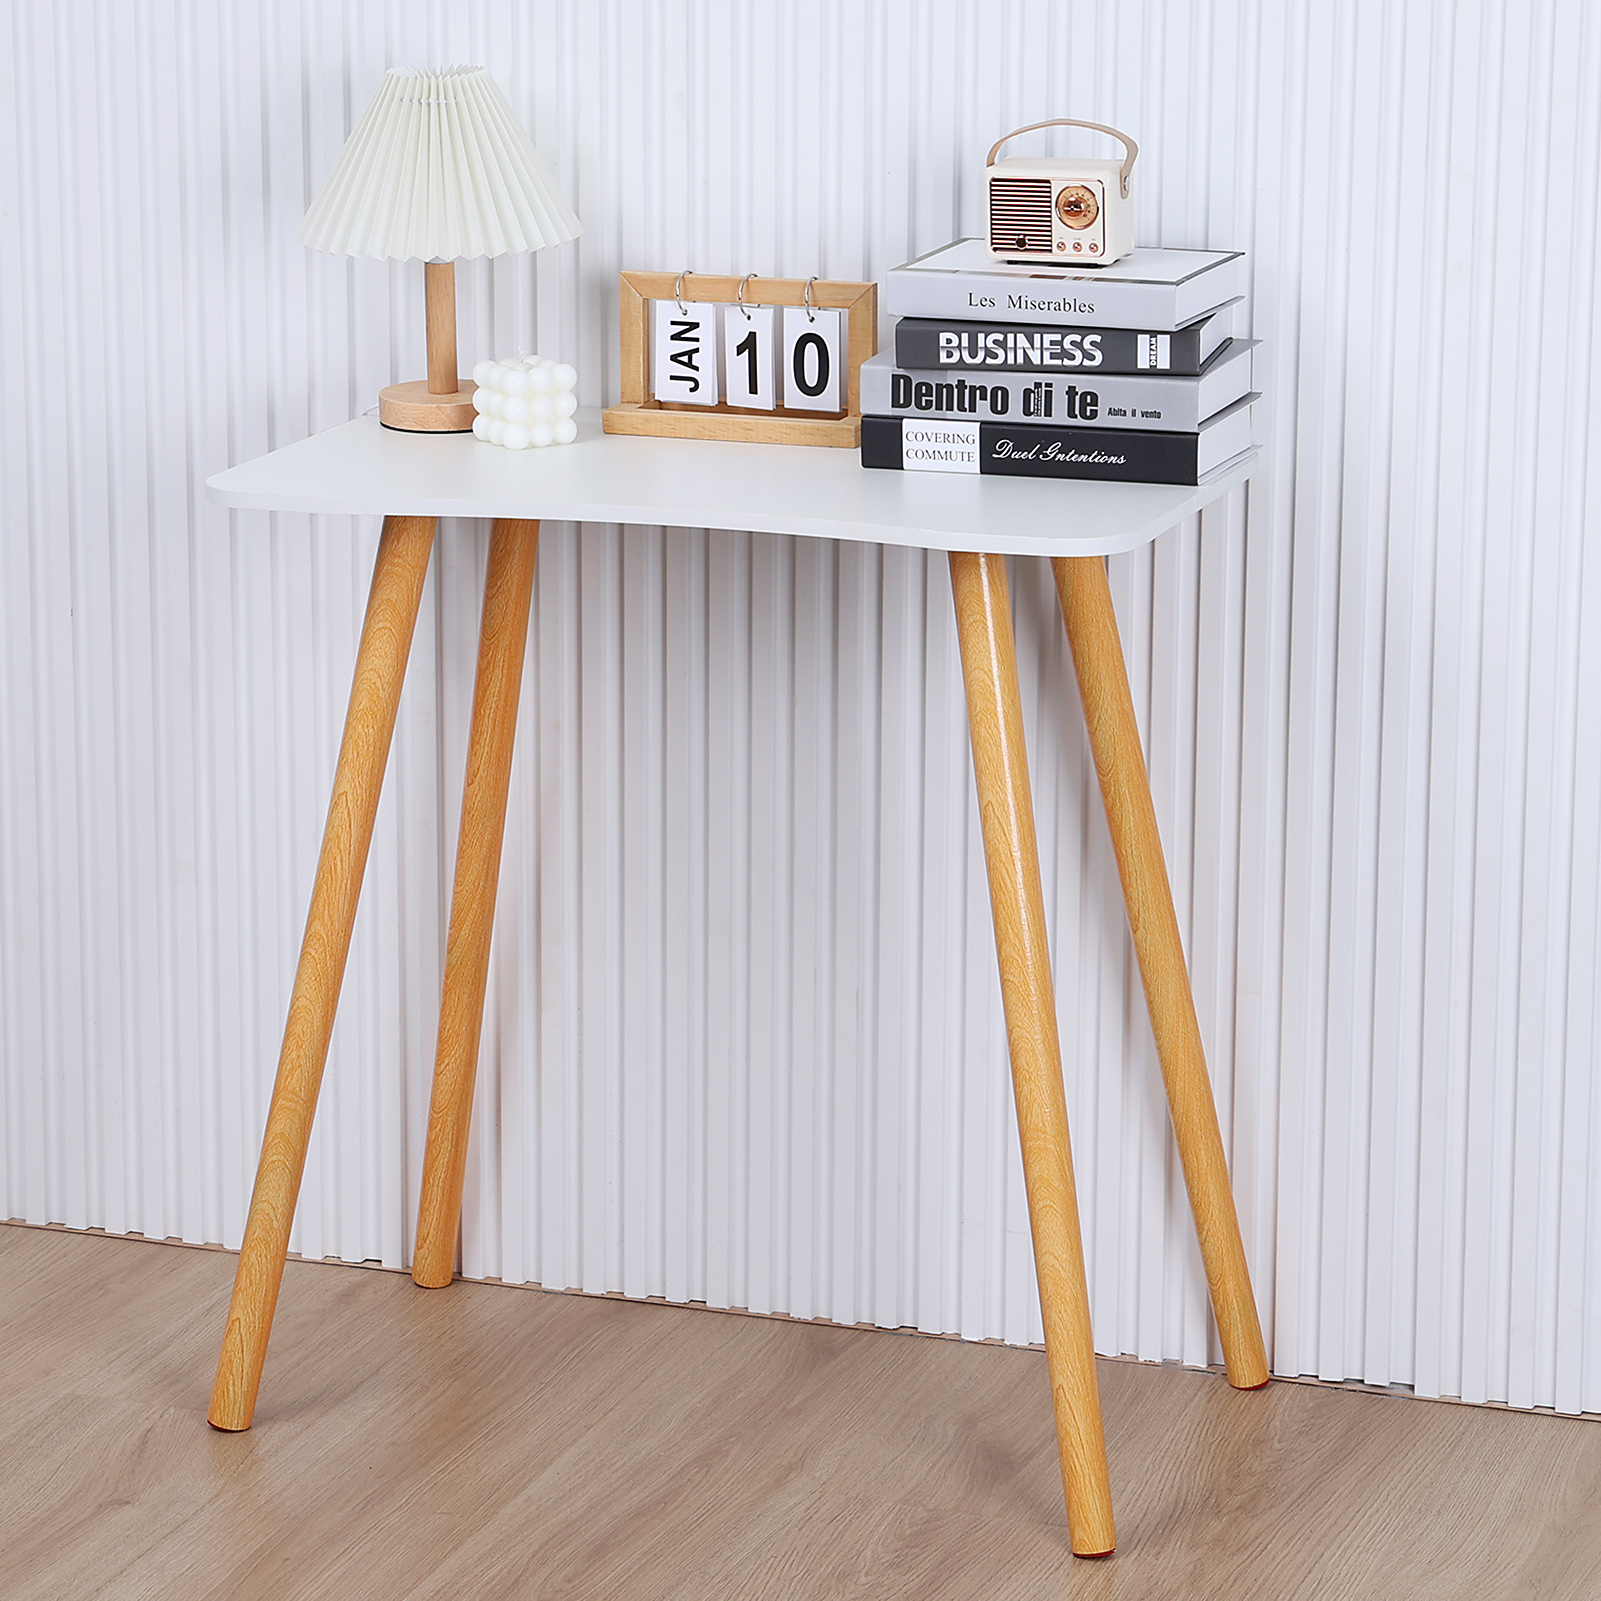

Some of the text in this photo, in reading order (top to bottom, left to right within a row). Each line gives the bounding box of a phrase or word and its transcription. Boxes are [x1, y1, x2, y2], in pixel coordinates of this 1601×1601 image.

[968, 292, 1095, 314] Les Miserables
[669, 320, 700, 393] JAN
[939, 332, 1104, 367] BUSINESS
[1149, 337, 1157, 366] DREAM
[736, 331, 830, 397] 1 0
[891, 373, 1010, 416] Dentro
[1022, 381, 1053, 418] di
[1065, 385, 1100, 420] te
[1107, 407, 1127, 417] Abita
[1140, 410, 1162, 419] vento
[905, 430, 976, 445] COVERING
[992, 439, 1041, 460] Duel
[905, 448, 976, 463] COMMUTE
